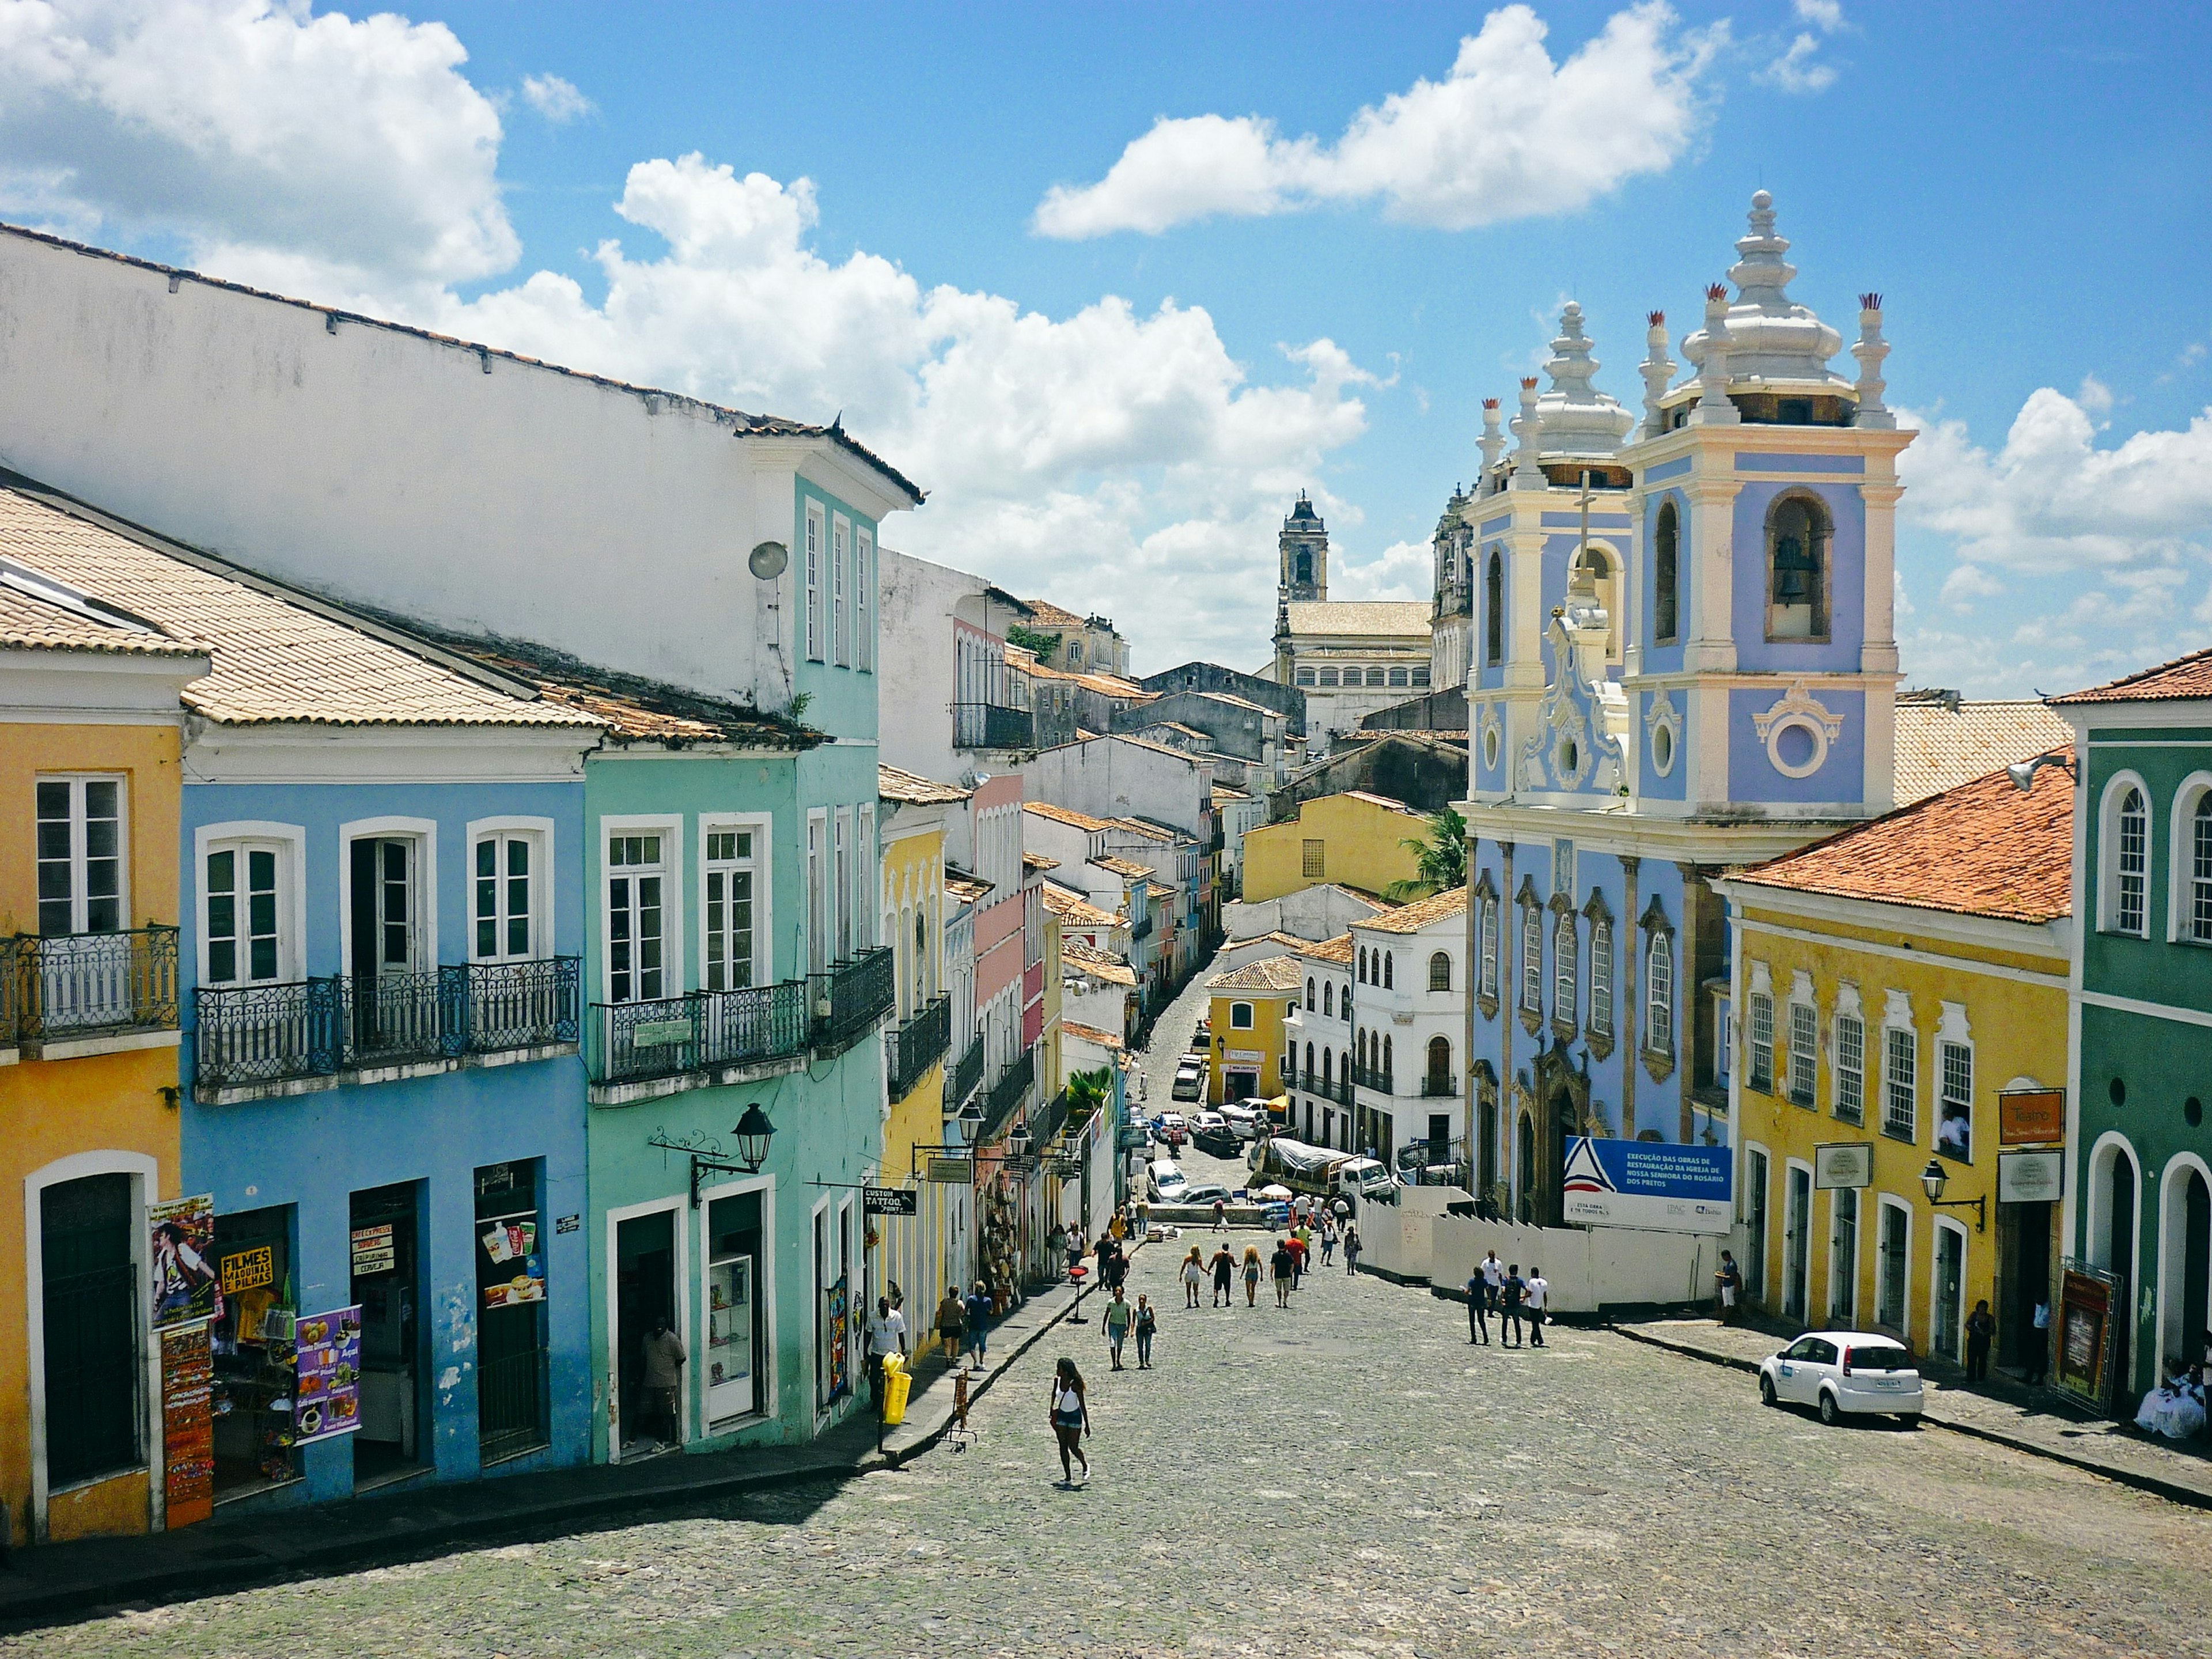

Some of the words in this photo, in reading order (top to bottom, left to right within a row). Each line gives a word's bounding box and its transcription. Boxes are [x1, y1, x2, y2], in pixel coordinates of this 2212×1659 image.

[1627, 1153, 1661, 1162] EXECUÇÃO
[1627, 1161, 1674, 1171] RESTAURAÇÃO
[1650, 1172, 1681, 1180] SENHORA
[1642, 1179, 1666, 1187] PRETOS
[223, 1250, 270, 1273] FILMES
[225, 1282, 231, 1291] E
[235, 1272, 271, 1290] PILHAS
